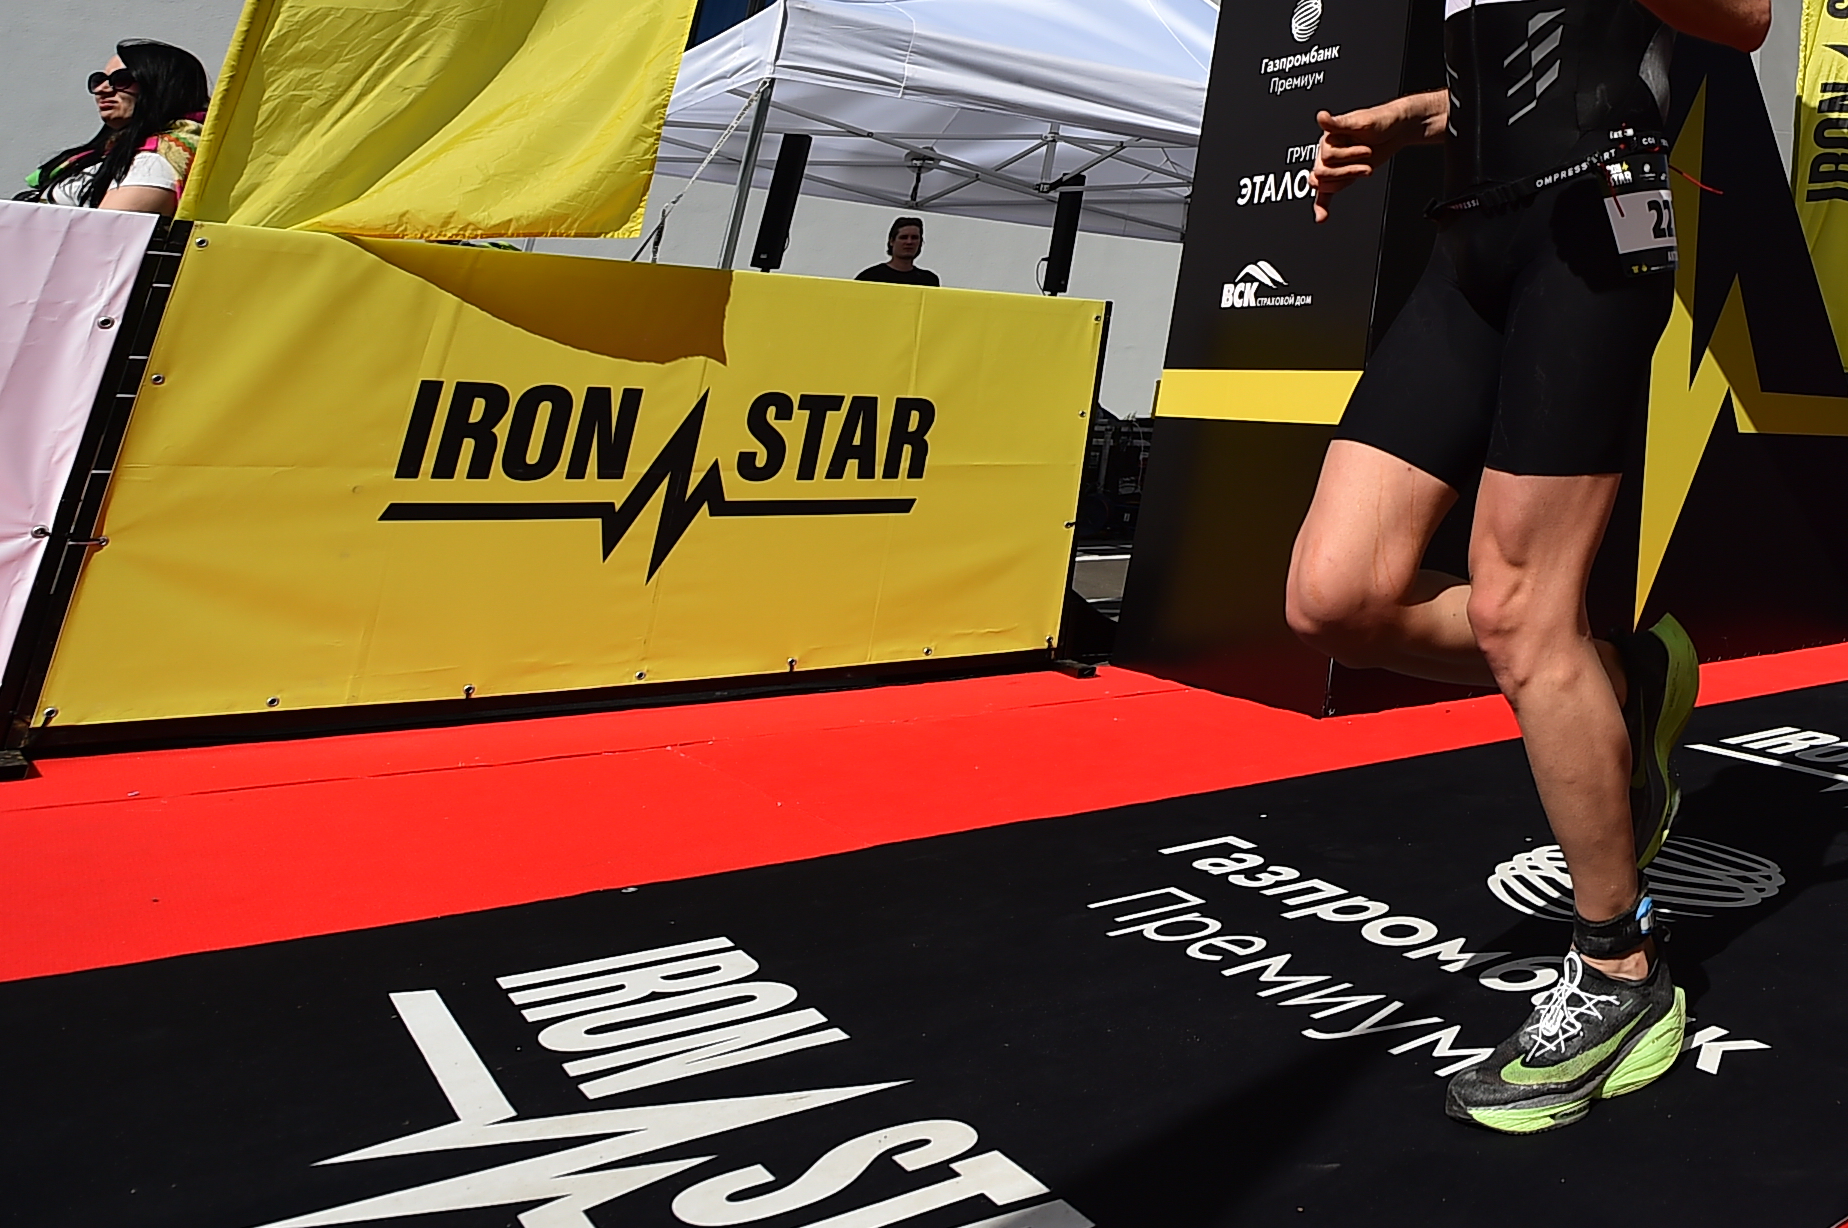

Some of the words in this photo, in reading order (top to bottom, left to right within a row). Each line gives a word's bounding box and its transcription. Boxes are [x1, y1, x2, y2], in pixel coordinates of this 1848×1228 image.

[1261, 45, 1340, 74] Газпромбанк
[1269, 70, 1325, 95] Премиум
[1236, 169, 1316, 206] ЭТАЛО
[1287, 143, 1320, 163] ГРУП
[1221, 281, 1259, 308] ВСК
[1257, 293, 1294, 307] СТРАХОВОЙ
[1295, 294, 1312, 306] ДОМ
[395, 380, 644, 482] IRON
[736, 393, 936, 481] STAR
[1086, 887, 1495, 1077] Премиум
[1158, 834, 1772, 1075] Газпромбк
[496, 936, 851, 1100] IRON
[672, 1119, 1097, 1228] ST
